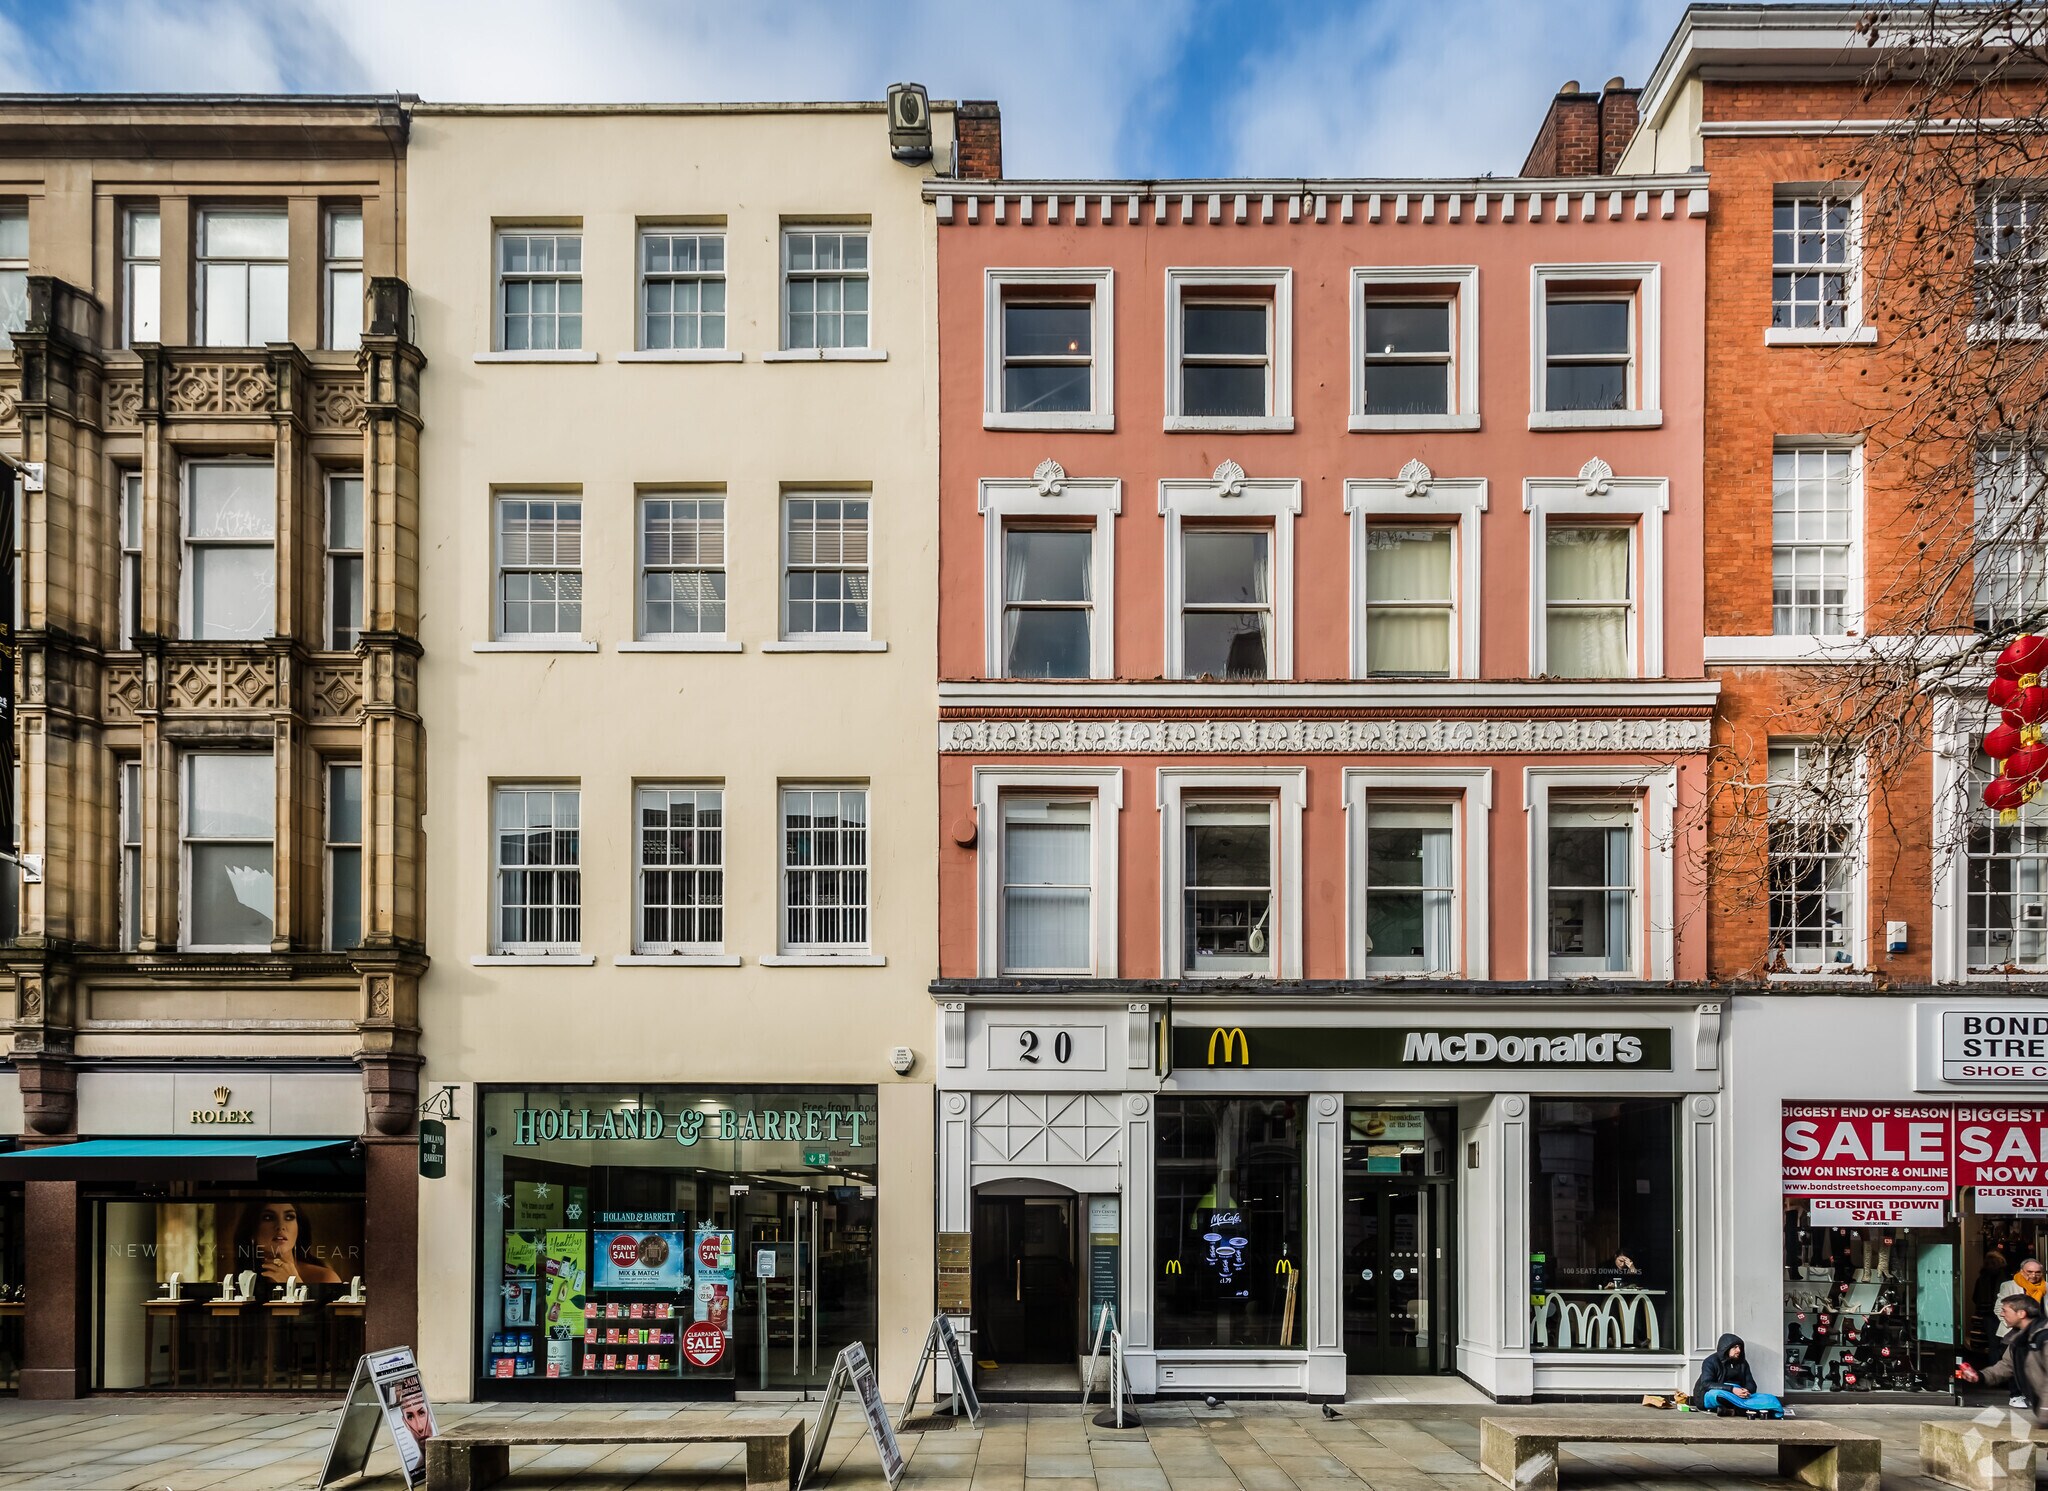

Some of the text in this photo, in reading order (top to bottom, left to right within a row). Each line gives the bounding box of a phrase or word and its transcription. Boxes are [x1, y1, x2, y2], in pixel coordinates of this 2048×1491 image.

[1963, 1017, 2048, 1035] BOND
[1402, 1032, 1643, 1063] McDonald's
[1962, 1066, 2025, 1076] SHOE
[190, 1110, 253, 1123] ROLEX
[1781, 1107, 1949, 1118] BIGGEST END OF SEASON
[1958, 1108, 2045, 1122] BIGGEST
[513, 1108, 868, 1147] HOLLAND & BARRETT
[1783, 1121, 1945, 1161] SALE
[423, 1153, 444, 1164] BARRETT
[1781, 1167, 1949, 1177] NOW ON INSTORE & ONLINE
[1976, 1167, 2038, 1182] NOW
[1784, 1183, 1945, 1192] www.bondstreetshoecompany.com
[1815, 1200, 1939, 1209] CLOSING DOWN
[603, 1213, 676, 1222] HOLLAND & BARRETT
[1851, 1210, 1903, 1221] SALE
[110, 1244, 159, 1258] NEW
[301, 1245, 360, 1259] YEAR
[612, 1251, 636, 1259] SALE
[686, 1336, 722, 1349] SALE
